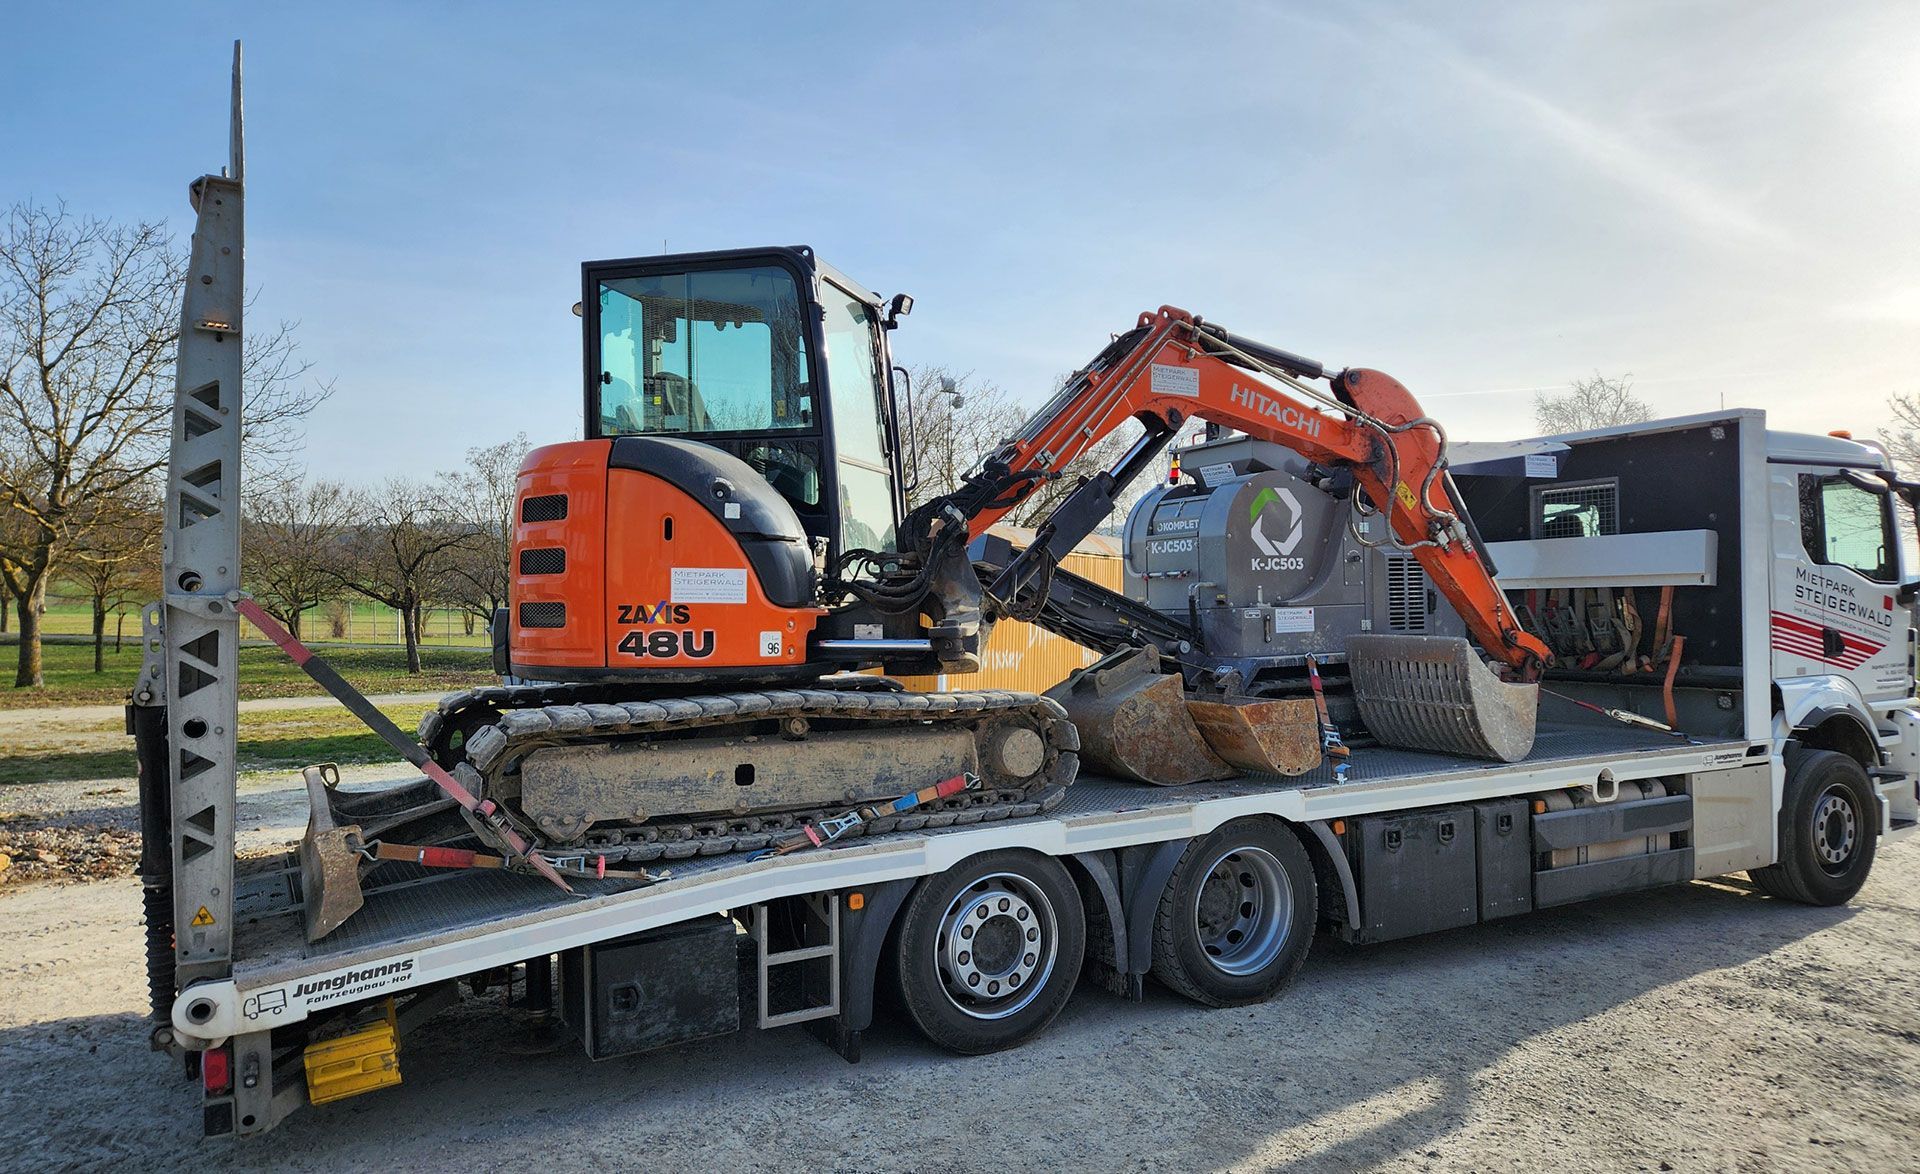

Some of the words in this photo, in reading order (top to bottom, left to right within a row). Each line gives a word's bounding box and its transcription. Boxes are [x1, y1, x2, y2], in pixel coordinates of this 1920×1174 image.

[1230, 383, 1321, 438] HITACHI
[1151, 539, 1193, 554] K-JC503
[1251, 557, 1304, 571] K-JC503
[674, 578, 744, 586] STEIGERWALD
[1796, 567, 1855, 598] MIETPARK
[617, 600, 690, 625] ZAXIS
[1795, 585, 1893, 628] STEIGERWALD
[617, 630, 716, 658] 48U
[767, 642, 780, 655] 96
[292, 959, 414, 998] Junghanns
